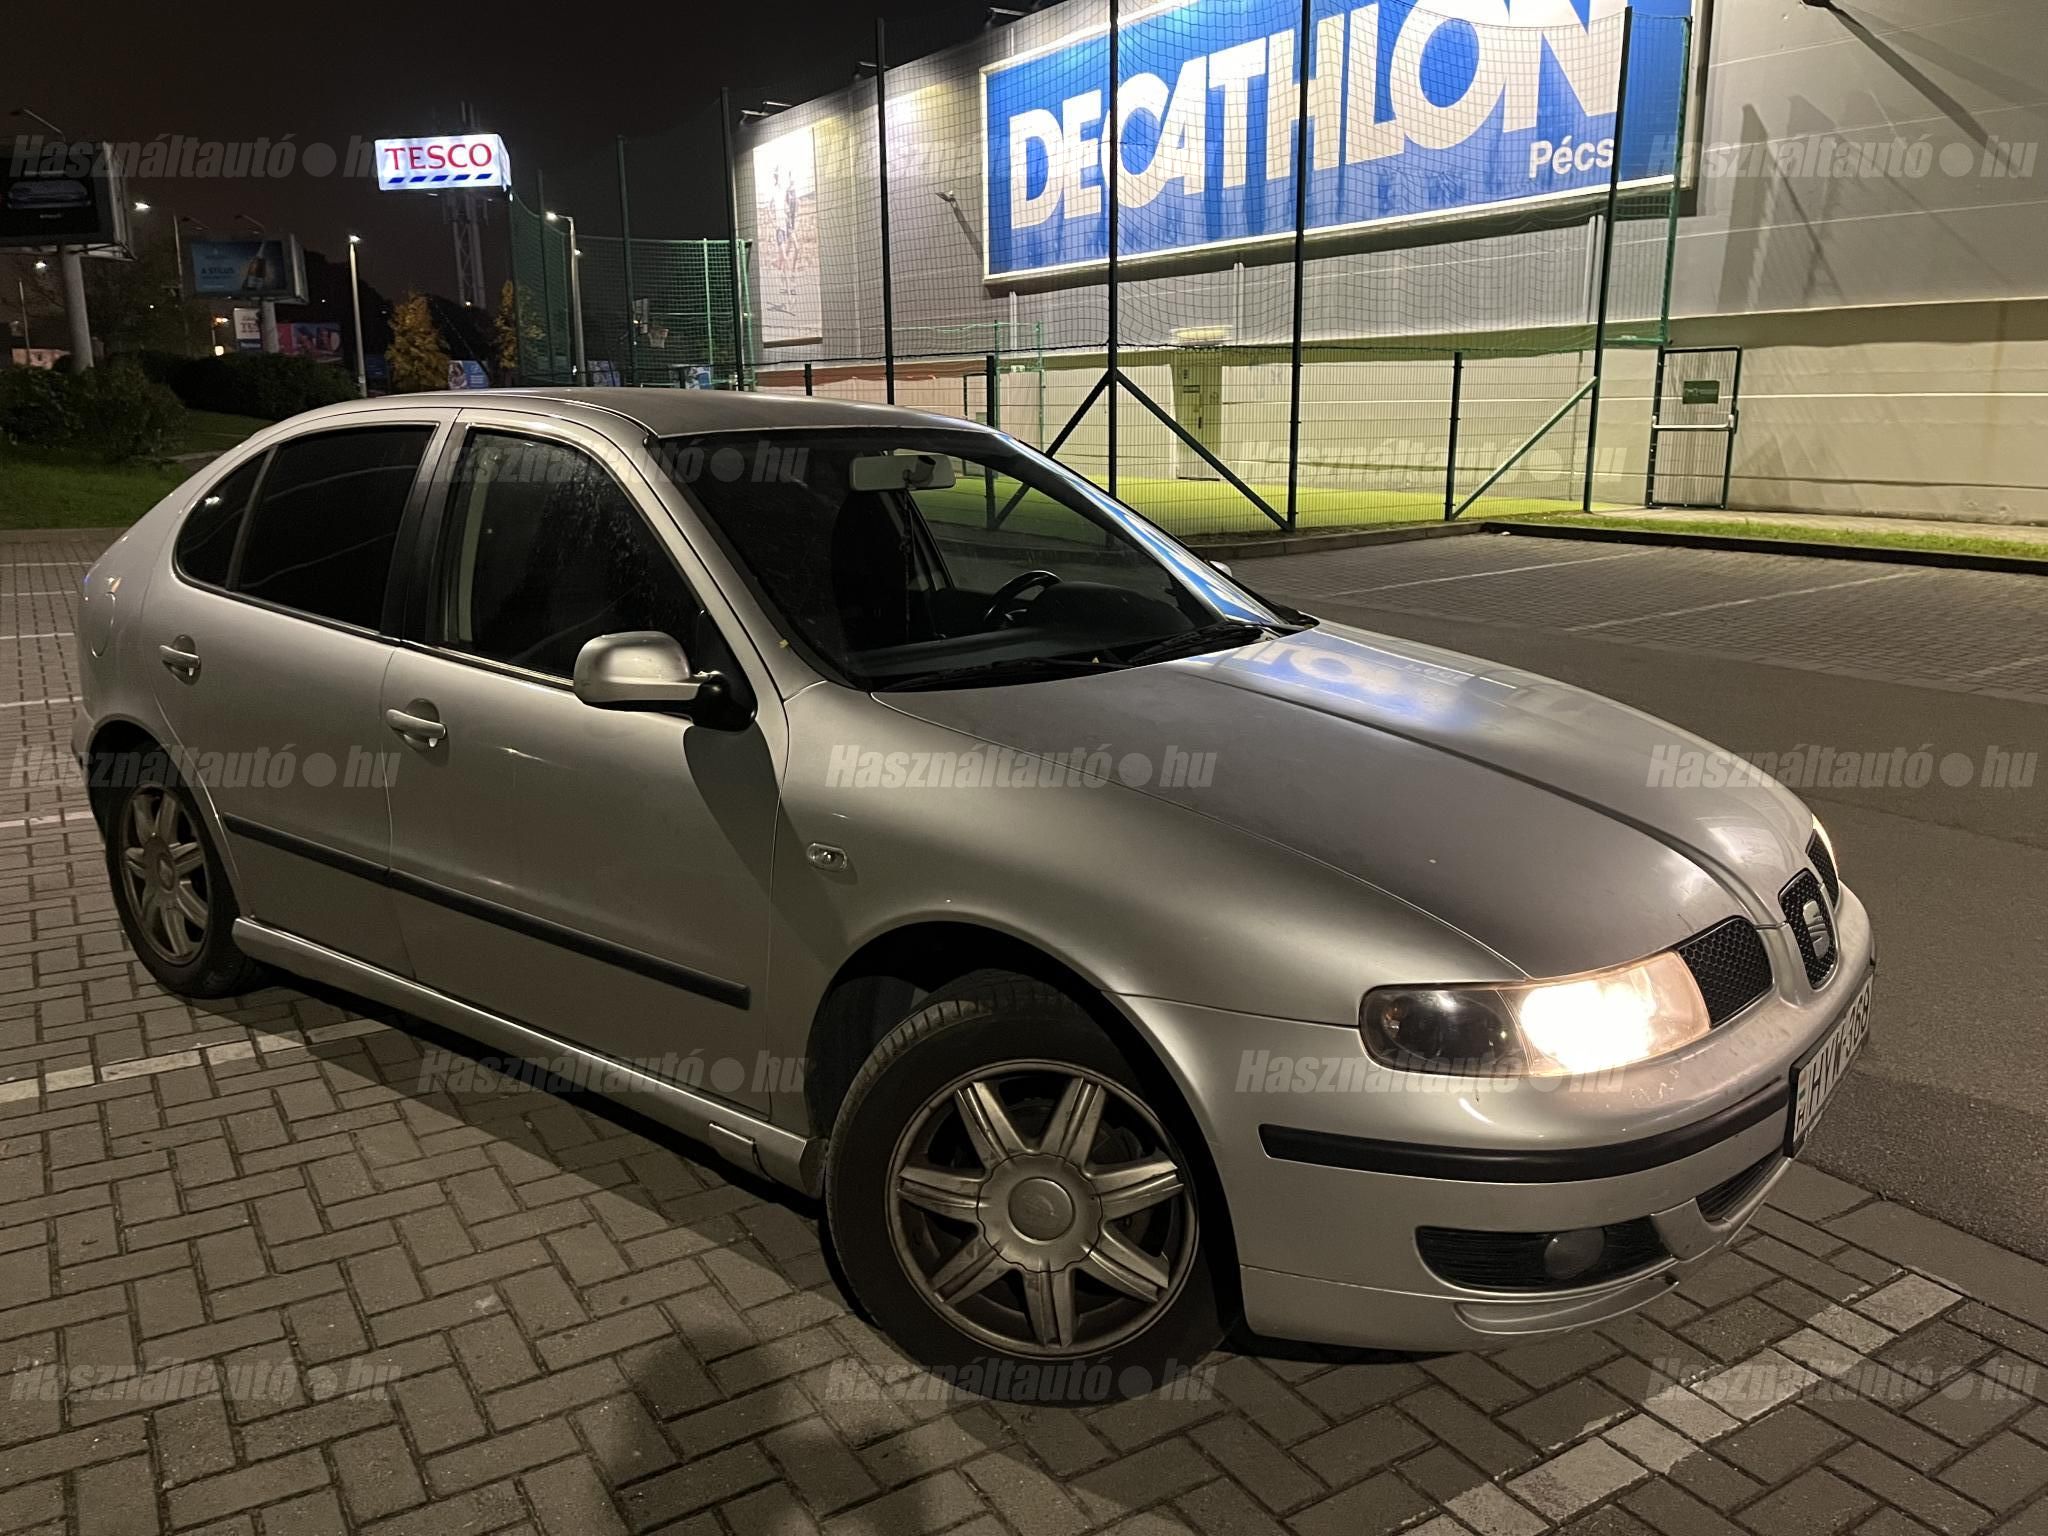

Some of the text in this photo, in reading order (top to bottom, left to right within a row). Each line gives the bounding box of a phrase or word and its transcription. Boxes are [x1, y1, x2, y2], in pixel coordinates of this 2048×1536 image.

[1010, 0, 1626, 230] DECATHLON
[384, 143, 492, 170] TESCO
[1528, 136, 1616, 179] Pécs
